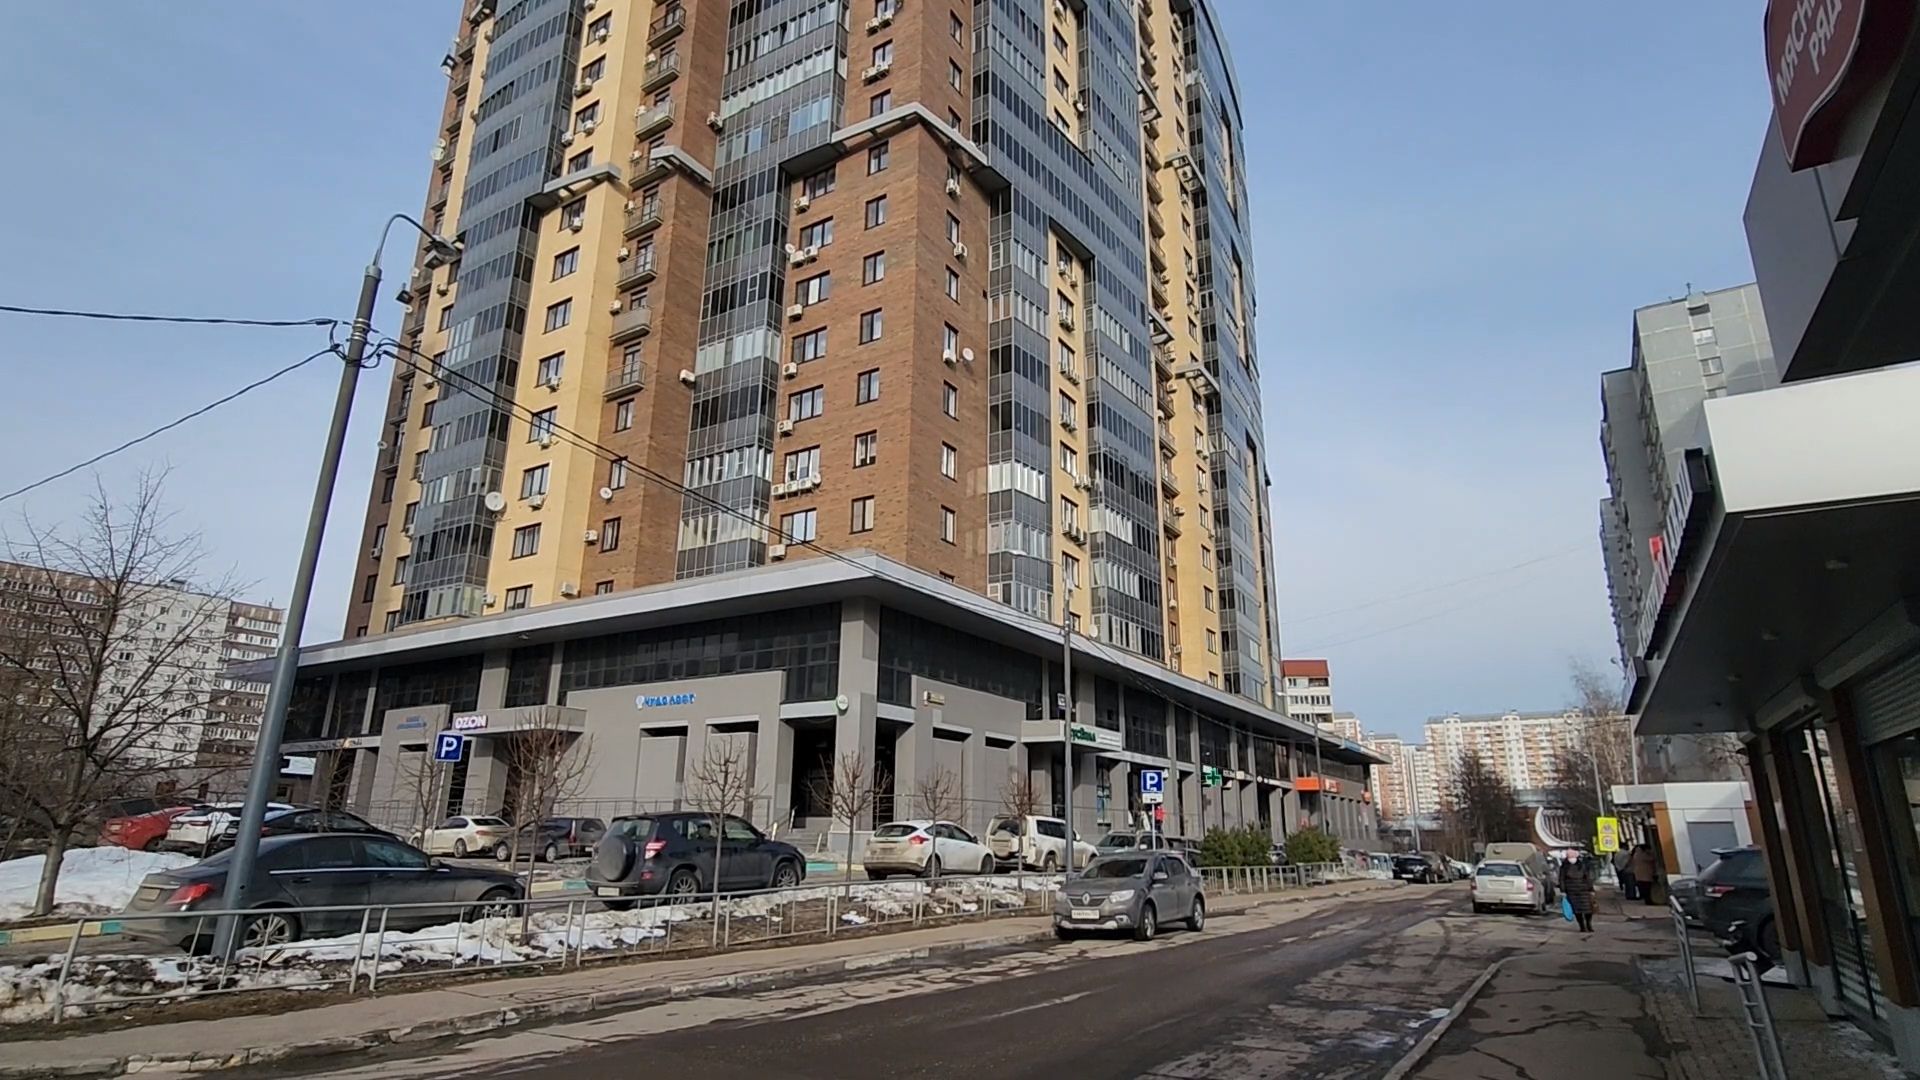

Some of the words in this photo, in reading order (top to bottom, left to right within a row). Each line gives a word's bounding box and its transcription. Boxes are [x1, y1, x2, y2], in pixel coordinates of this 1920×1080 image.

[1776, 0, 1815, 106] МЯСН
[454, 715, 488, 731] OZON
[440, 736, 457, 758] P
